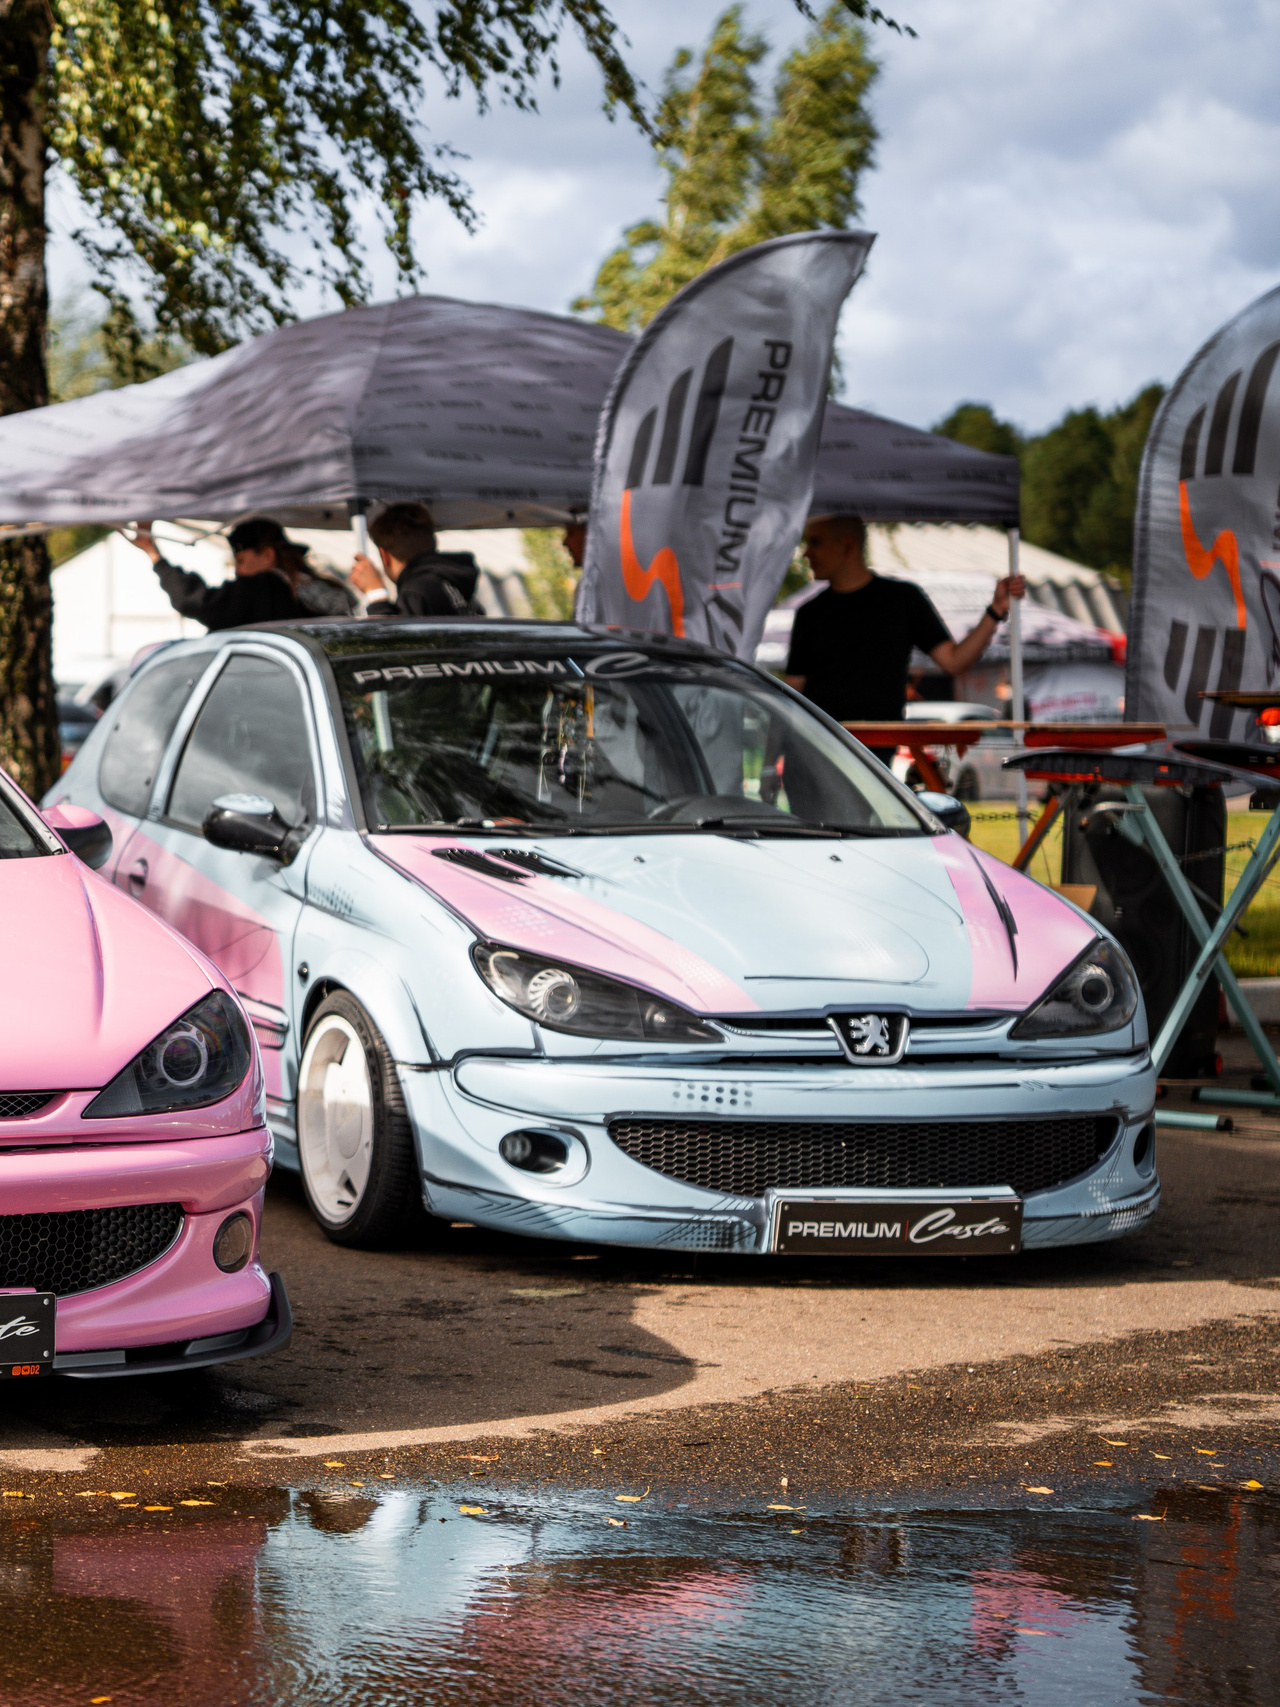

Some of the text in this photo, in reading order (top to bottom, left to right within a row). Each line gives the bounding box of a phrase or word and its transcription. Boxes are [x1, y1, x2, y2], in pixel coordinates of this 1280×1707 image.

[715, 338, 793, 573] PREMIUM
[353, 659, 568, 684] PREMIUM
[787, 1207, 1010, 1244] PREMIUM Caste
